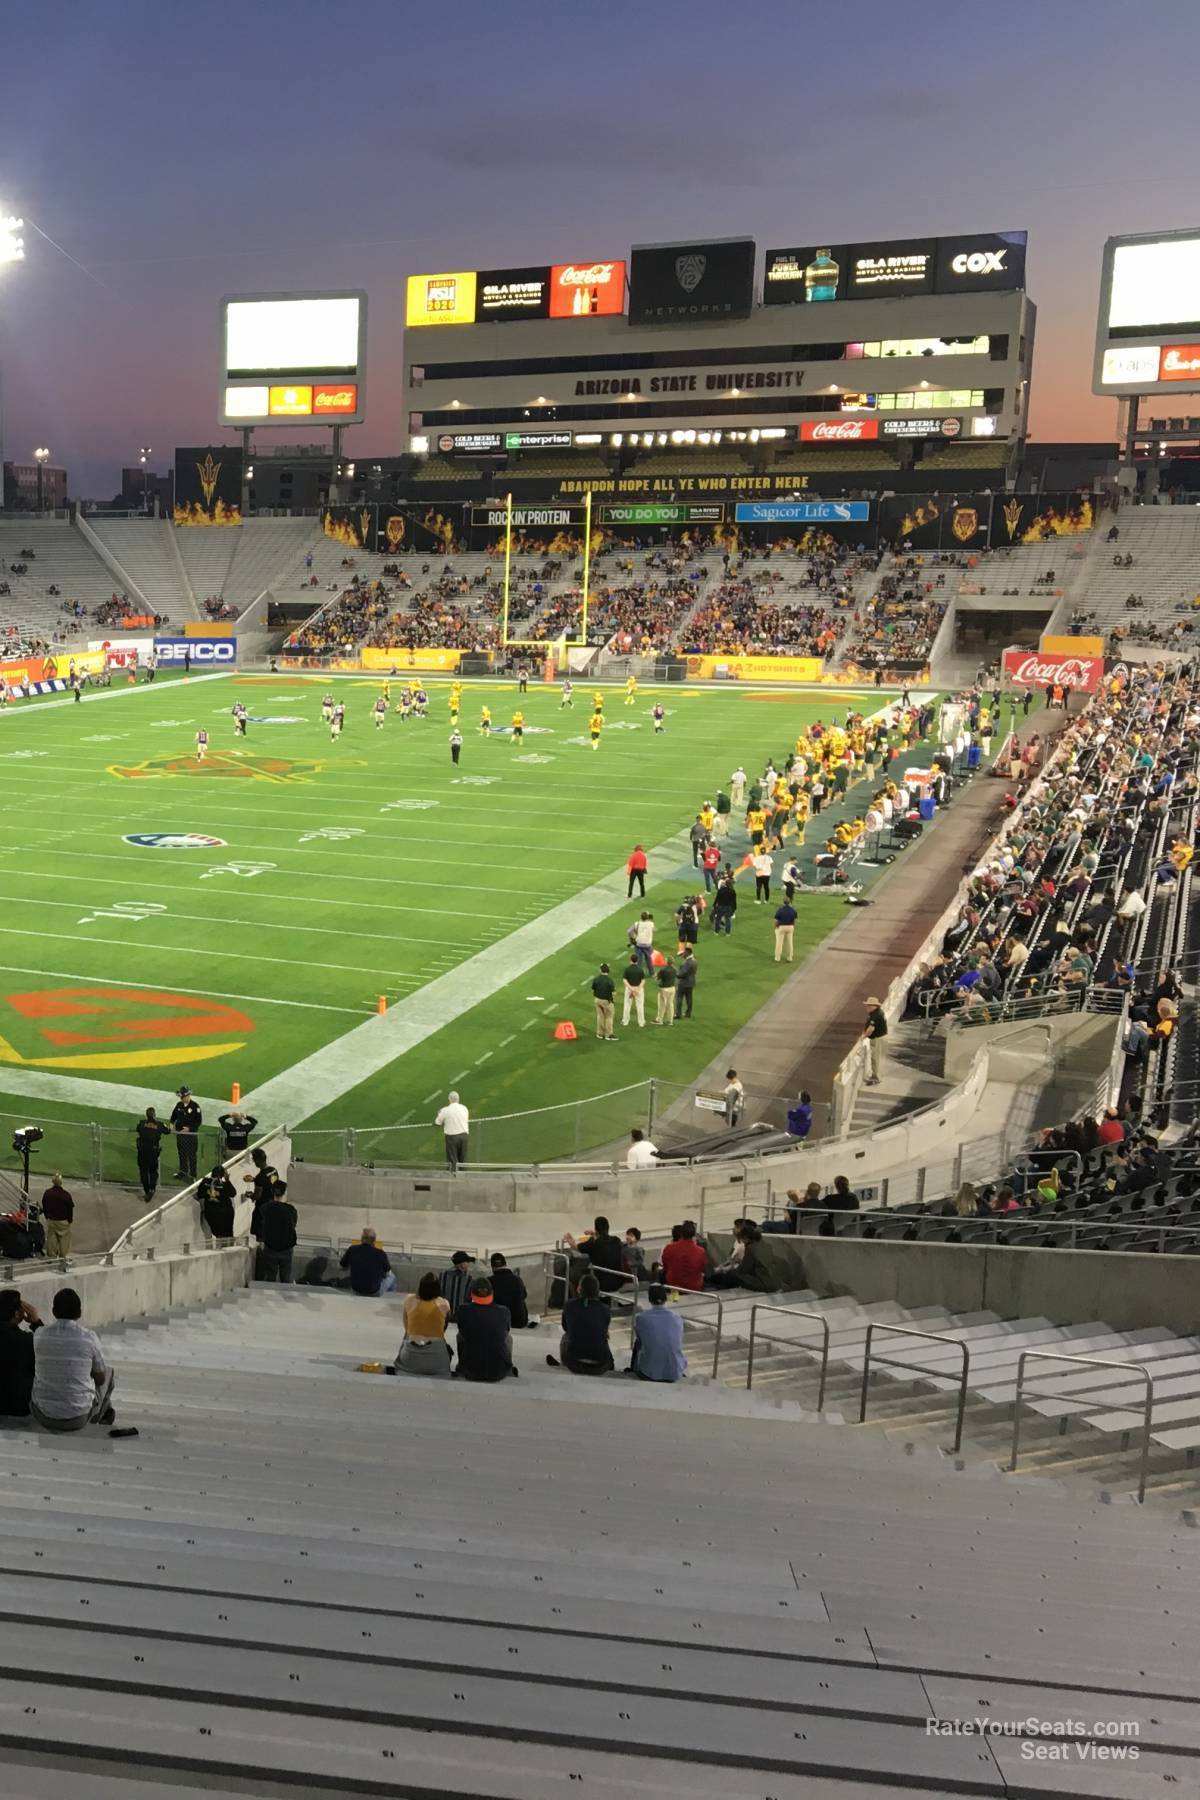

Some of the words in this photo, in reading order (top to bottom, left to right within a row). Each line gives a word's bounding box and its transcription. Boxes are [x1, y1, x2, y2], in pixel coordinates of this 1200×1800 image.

[856, 258, 886, 270] GILA
[888, 256, 927, 267] RIVER
[952, 249, 1007, 274] COX
[683, 274, 697, 286] 12
[483, 285, 509, 295] GILA
[509, 283, 541, 294] RIVER
[645, 304, 732, 316] NETWORKS
[575, 378, 641, 396] ARIZONA
[650, 375, 697, 392] STATE
[706, 371, 806, 390] UNIVERSITY
[812, 422, 866, 439] Coca-Cola
[511, 435, 570, 446] enterprise
[560, 481, 615, 493] ABANDON
[618, 480, 650, 491] HOPE
[653, 479, 675, 491] ALL
[678, 479, 695, 490] YE
[698, 478, 727, 490] WHO
[730, 477, 771, 489] ENTER
[775, 476, 809, 488] HERE
[527, 510, 571, 525] PROTEIN
[609, 508, 633, 519] YOU
[635, 508, 652, 518] DO
[654, 508, 679, 518] YOU
[753, 504, 802, 520] Sagicor
[805, 503, 830, 518] Life
[156, 643, 234, 660] GEICO
[93, 901, 168, 921] 10
[860, 1188, 873, 1200] 13
